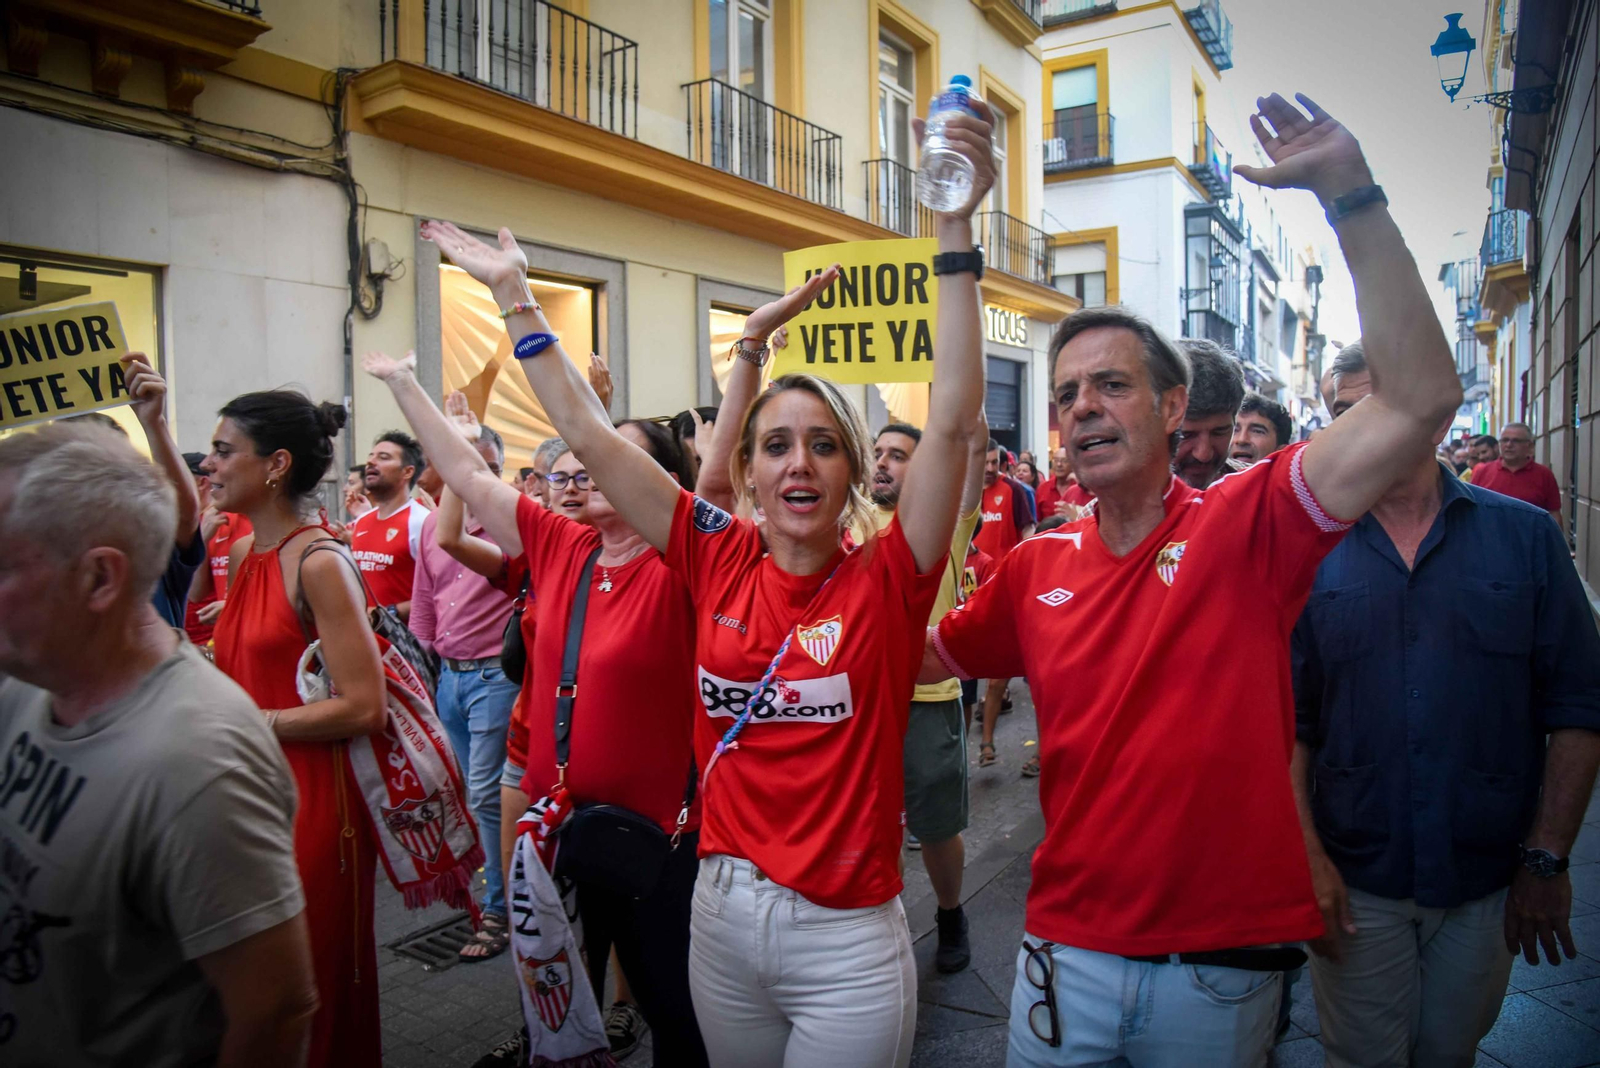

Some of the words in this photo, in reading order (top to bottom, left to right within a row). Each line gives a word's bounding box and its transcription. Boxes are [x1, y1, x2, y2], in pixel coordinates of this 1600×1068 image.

[799, 321, 876, 364] VETE
[886, 319, 934, 362] YA
[0, 372, 75, 421] ETE
[77, 362, 130, 403] YA
[352, 550, 394, 565] ARATHON
[360, 561, 376, 571] BET
[701, 676, 847, 719] 888.com
[0, 730, 88, 846] SPIN
